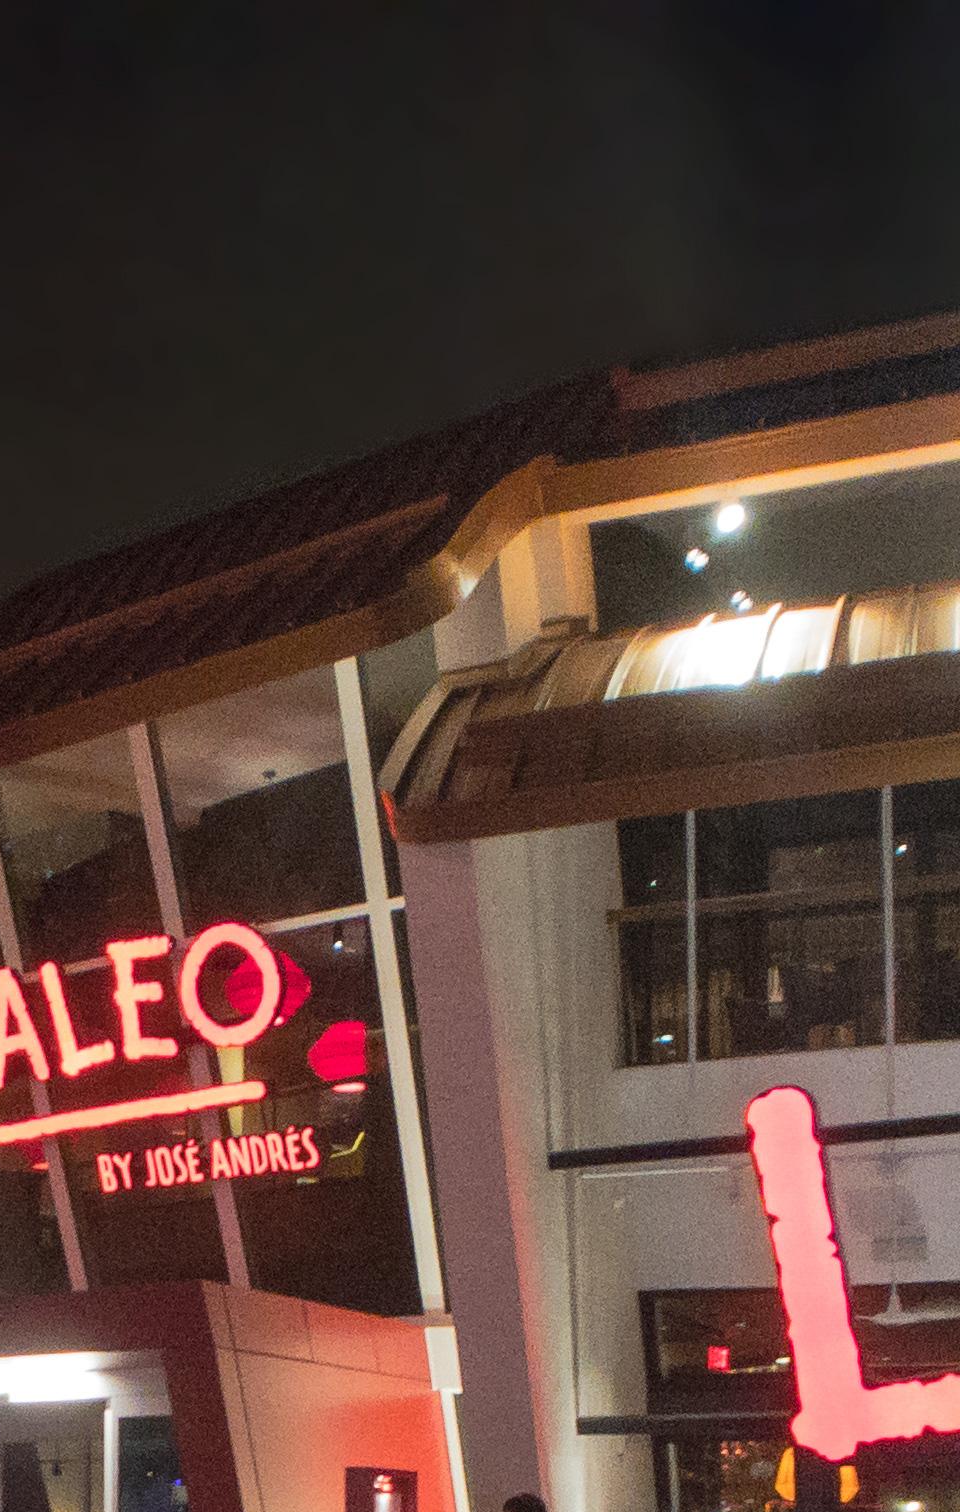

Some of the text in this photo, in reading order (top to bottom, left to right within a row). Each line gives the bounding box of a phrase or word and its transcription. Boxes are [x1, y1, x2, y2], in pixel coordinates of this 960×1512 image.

[95, 1124, 321, 1194] BY JOSÉ ANDRÉS
